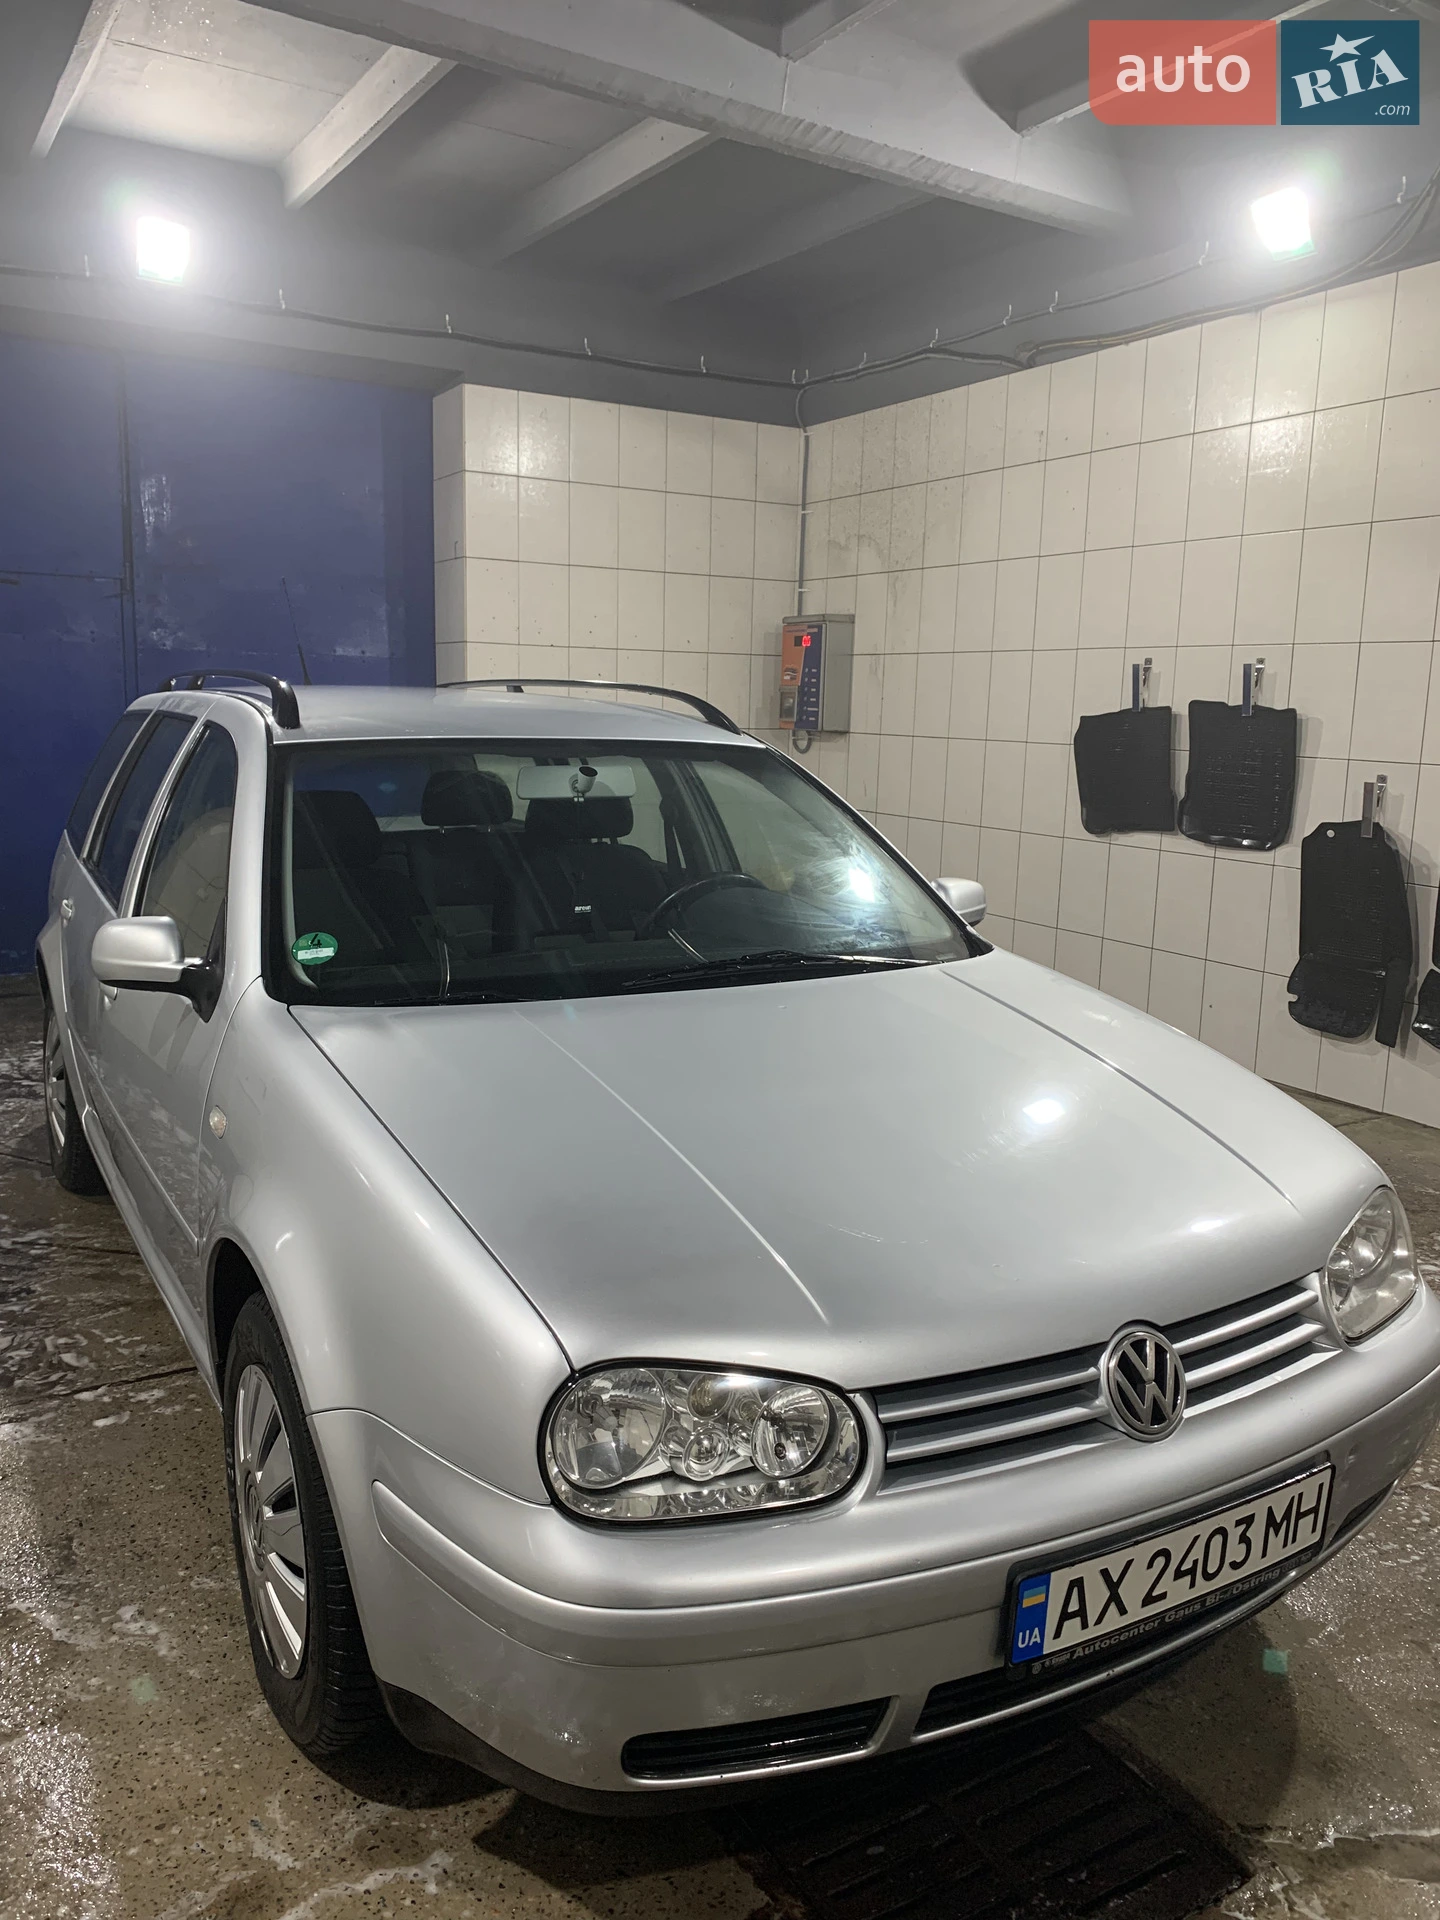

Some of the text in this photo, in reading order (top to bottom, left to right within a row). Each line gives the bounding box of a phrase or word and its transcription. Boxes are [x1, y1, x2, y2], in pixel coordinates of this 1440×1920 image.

[1052, 1482, 1325, 1640] AX 2403 MH
[1018, 1627, 1041, 1649] UA
[1072, 1619, 1160, 1660] Autocenter
